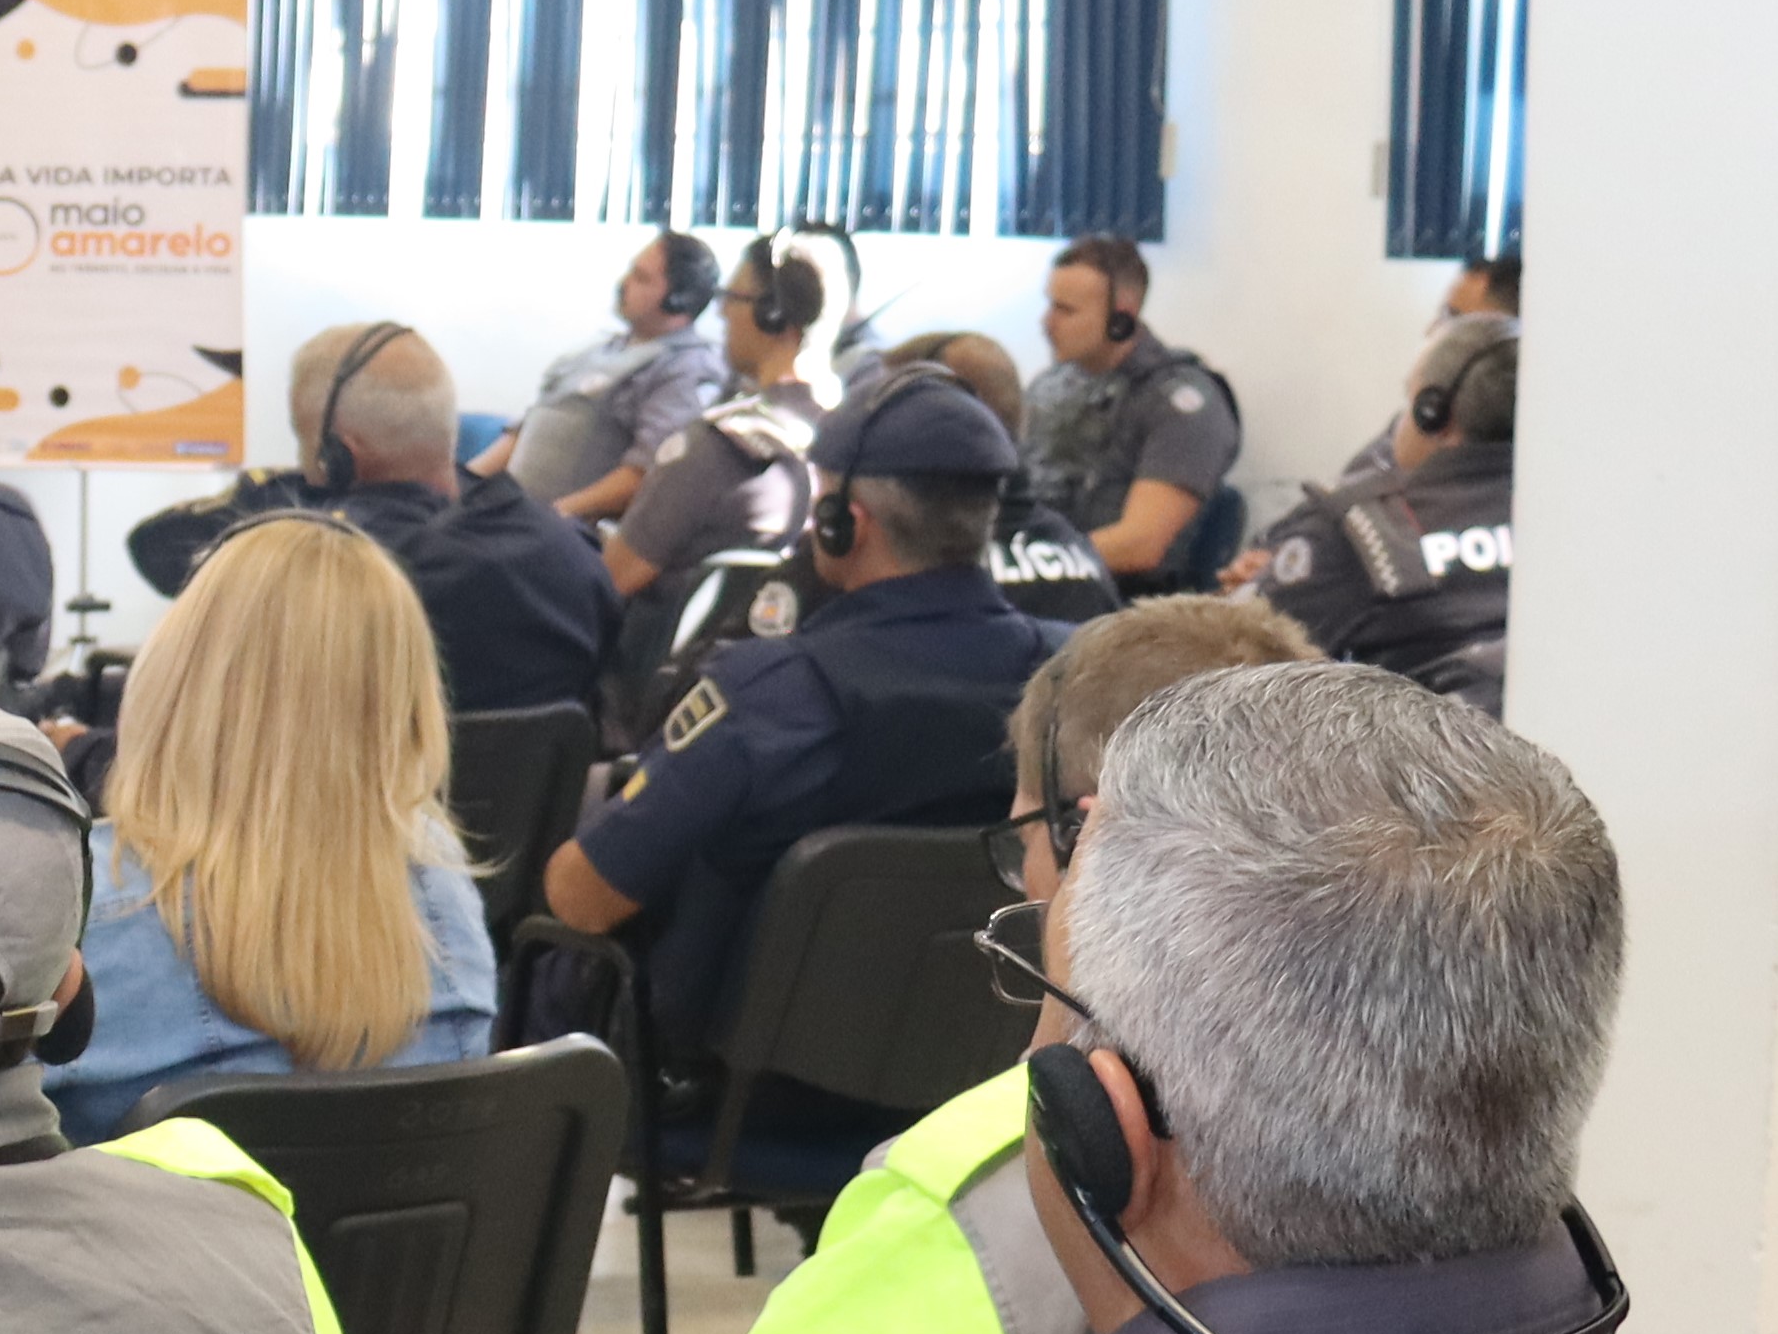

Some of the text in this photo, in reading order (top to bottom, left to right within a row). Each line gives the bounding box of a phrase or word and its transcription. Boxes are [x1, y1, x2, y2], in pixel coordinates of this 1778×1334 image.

[26, 166, 94, 186] VIDA
[103, 165, 232, 186] IMPORTA
[50, 196, 146, 227] maio
[49, 222, 232, 258] amarelo
[987, 529, 1102, 584] LÍCIA
